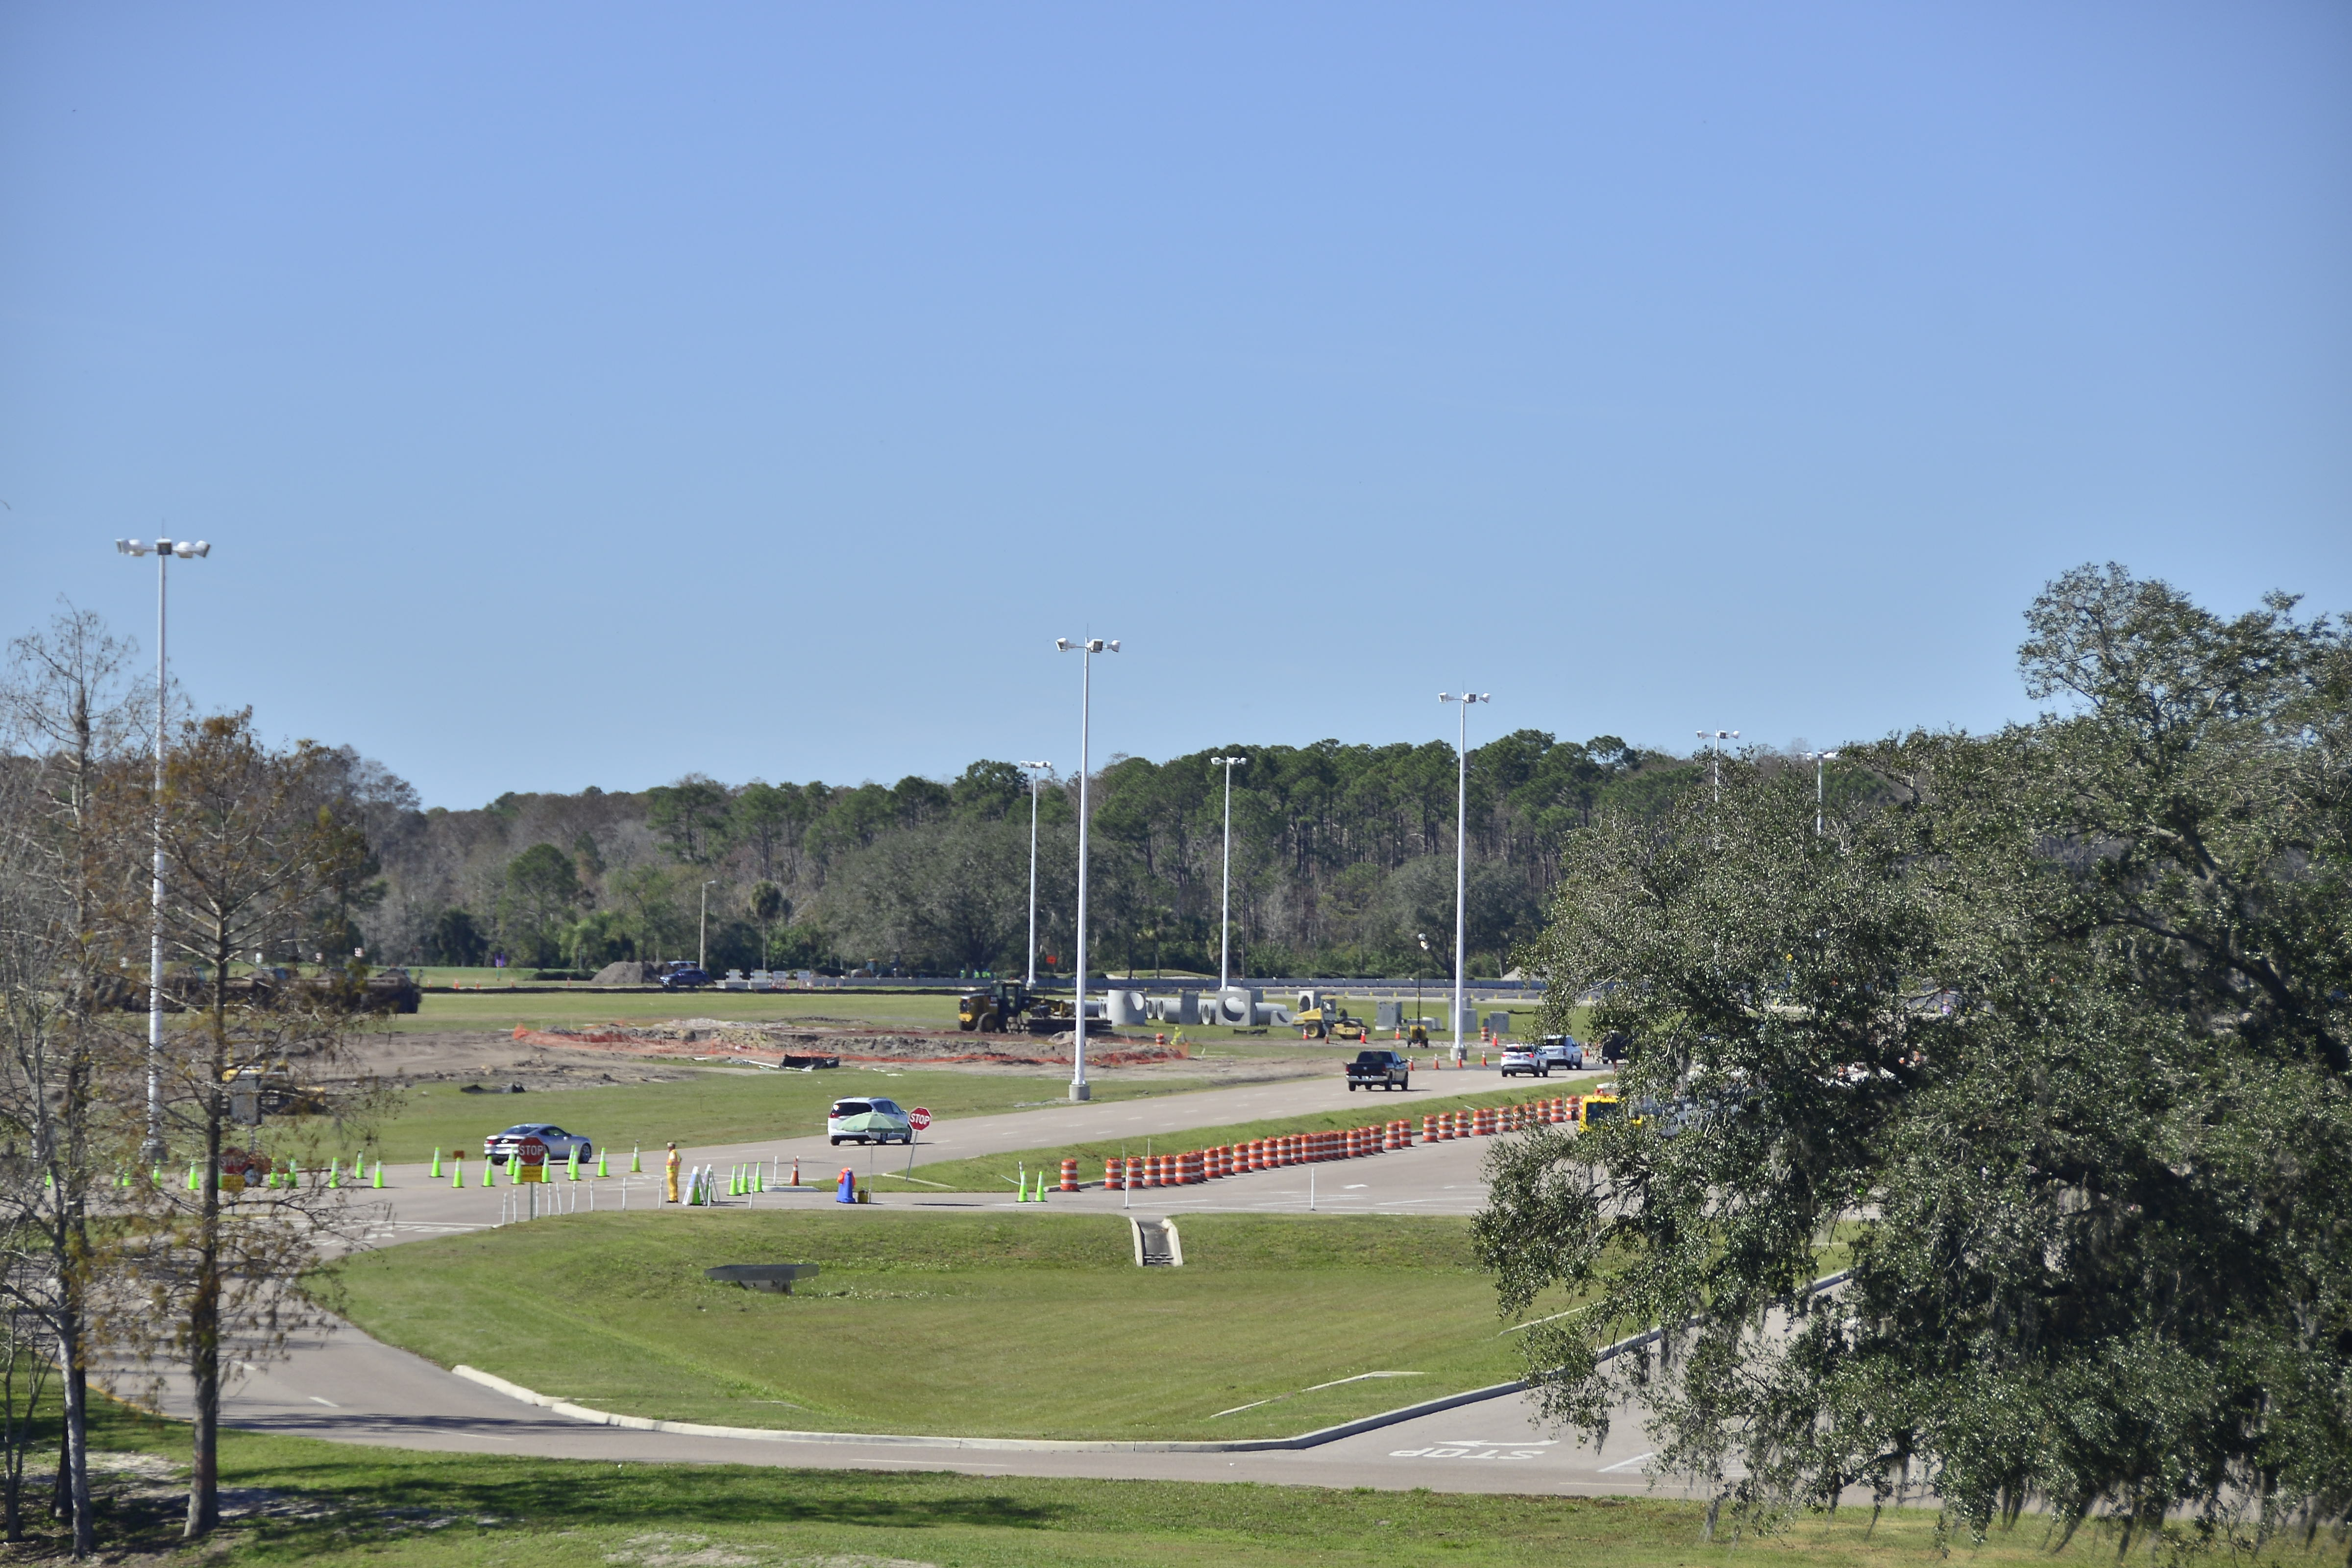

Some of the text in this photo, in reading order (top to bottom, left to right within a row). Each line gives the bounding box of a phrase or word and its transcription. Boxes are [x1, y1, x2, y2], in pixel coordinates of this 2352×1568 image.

[910, 1113, 930, 1125] STOP
[519, 1146, 543, 1155] STOP
[1389, 1447, 1545, 1459] STOP
